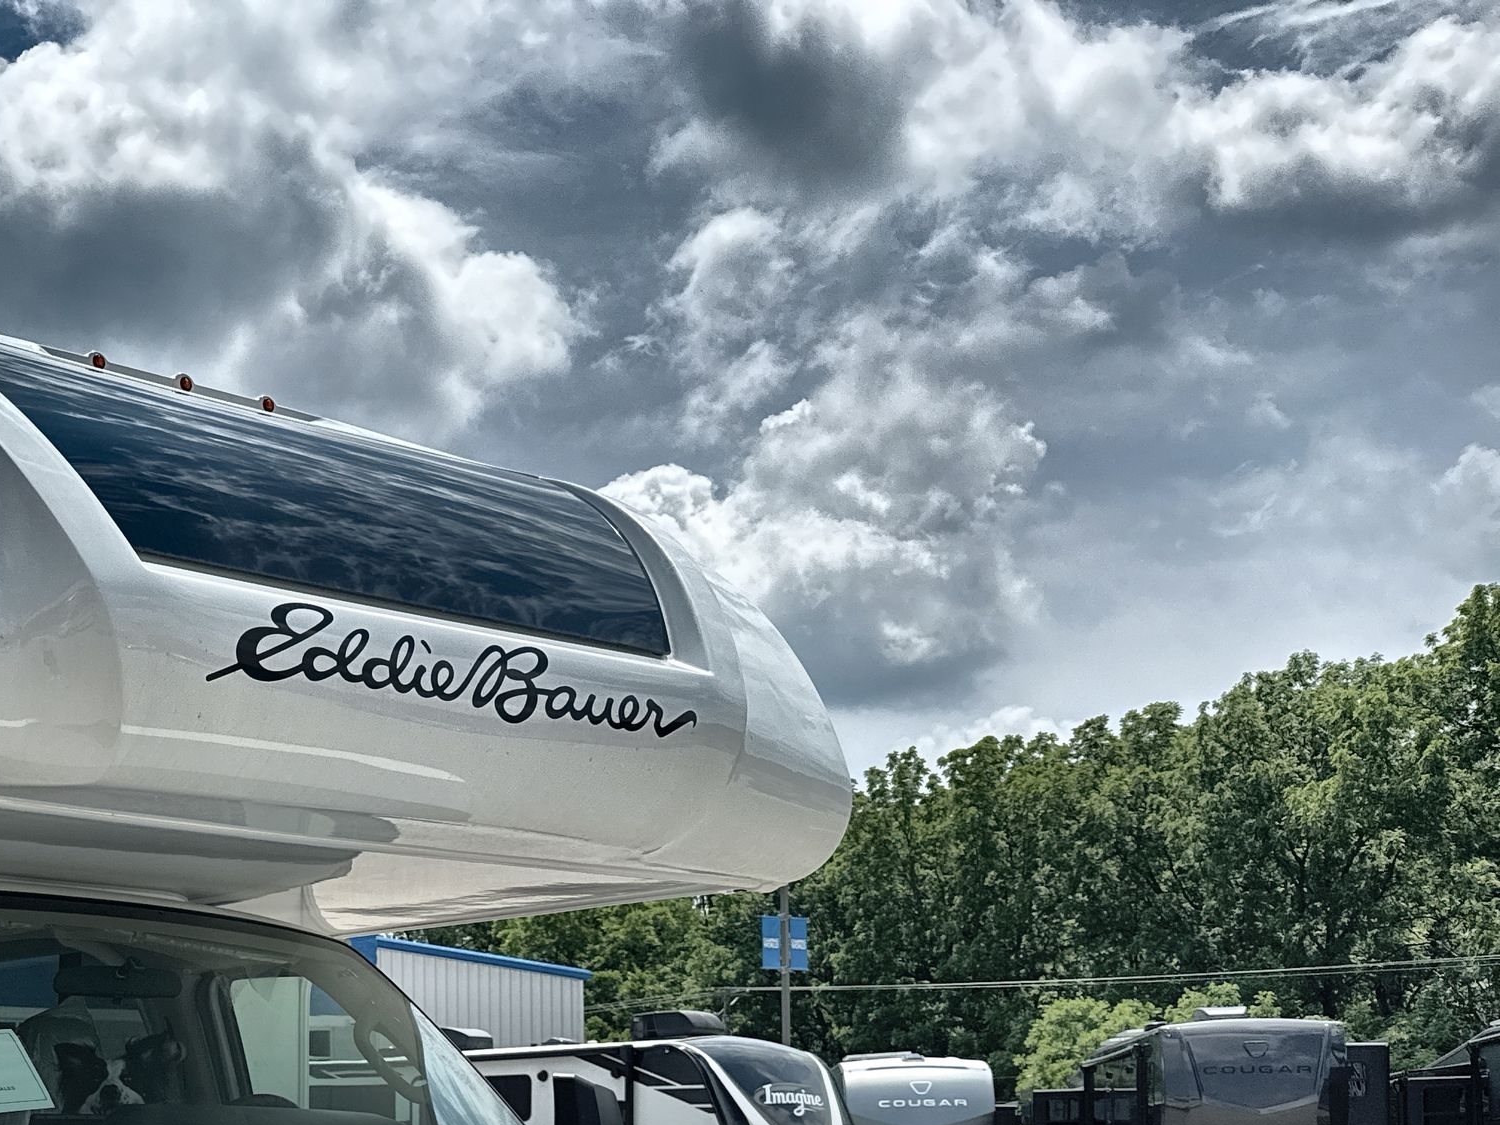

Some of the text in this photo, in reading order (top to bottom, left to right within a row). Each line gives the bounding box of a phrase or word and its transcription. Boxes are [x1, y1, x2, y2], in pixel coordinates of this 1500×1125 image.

[205, 601, 698, 739] Eddie Bauer
[1202, 1065, 1312, 1075] COUGAR
[762, 1083, 825, 1117] Imagine
[878, 1098, 968, 1109] COUGAR
